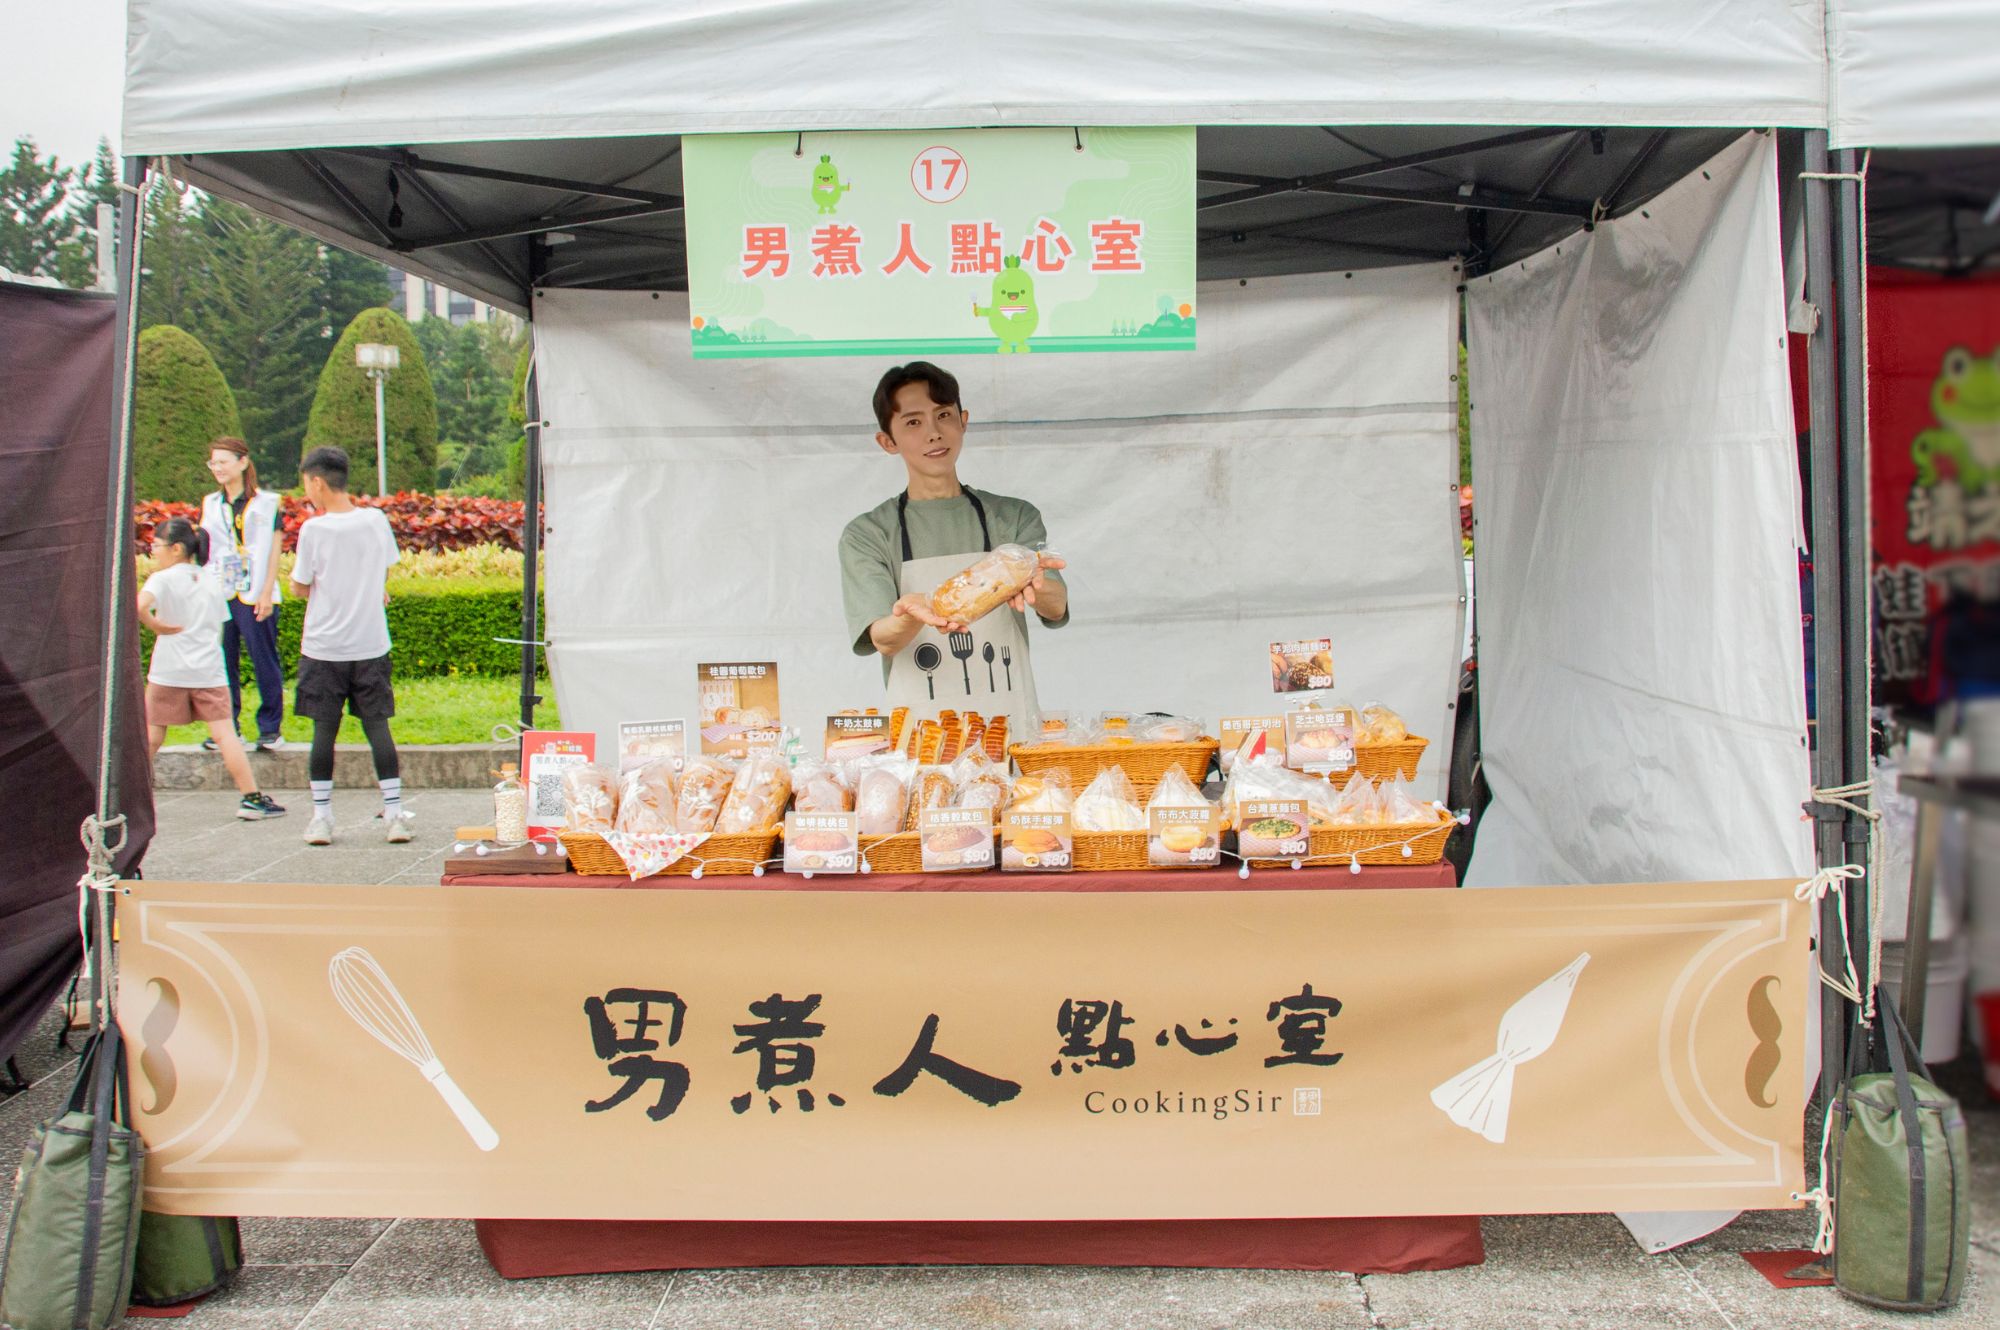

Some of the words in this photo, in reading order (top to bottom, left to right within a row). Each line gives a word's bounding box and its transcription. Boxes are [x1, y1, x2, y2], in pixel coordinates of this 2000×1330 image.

[919, 159, 962, 191] 17
[742, 218, 1144, 278] 男煮人點心室
[747, 731, 775, 743] $200
[826, 854, 853, 869] $90
[583, 983, 1344, 1121] 男煮人點心室
[1084, 1088, 1284, 1121] CookingSir
